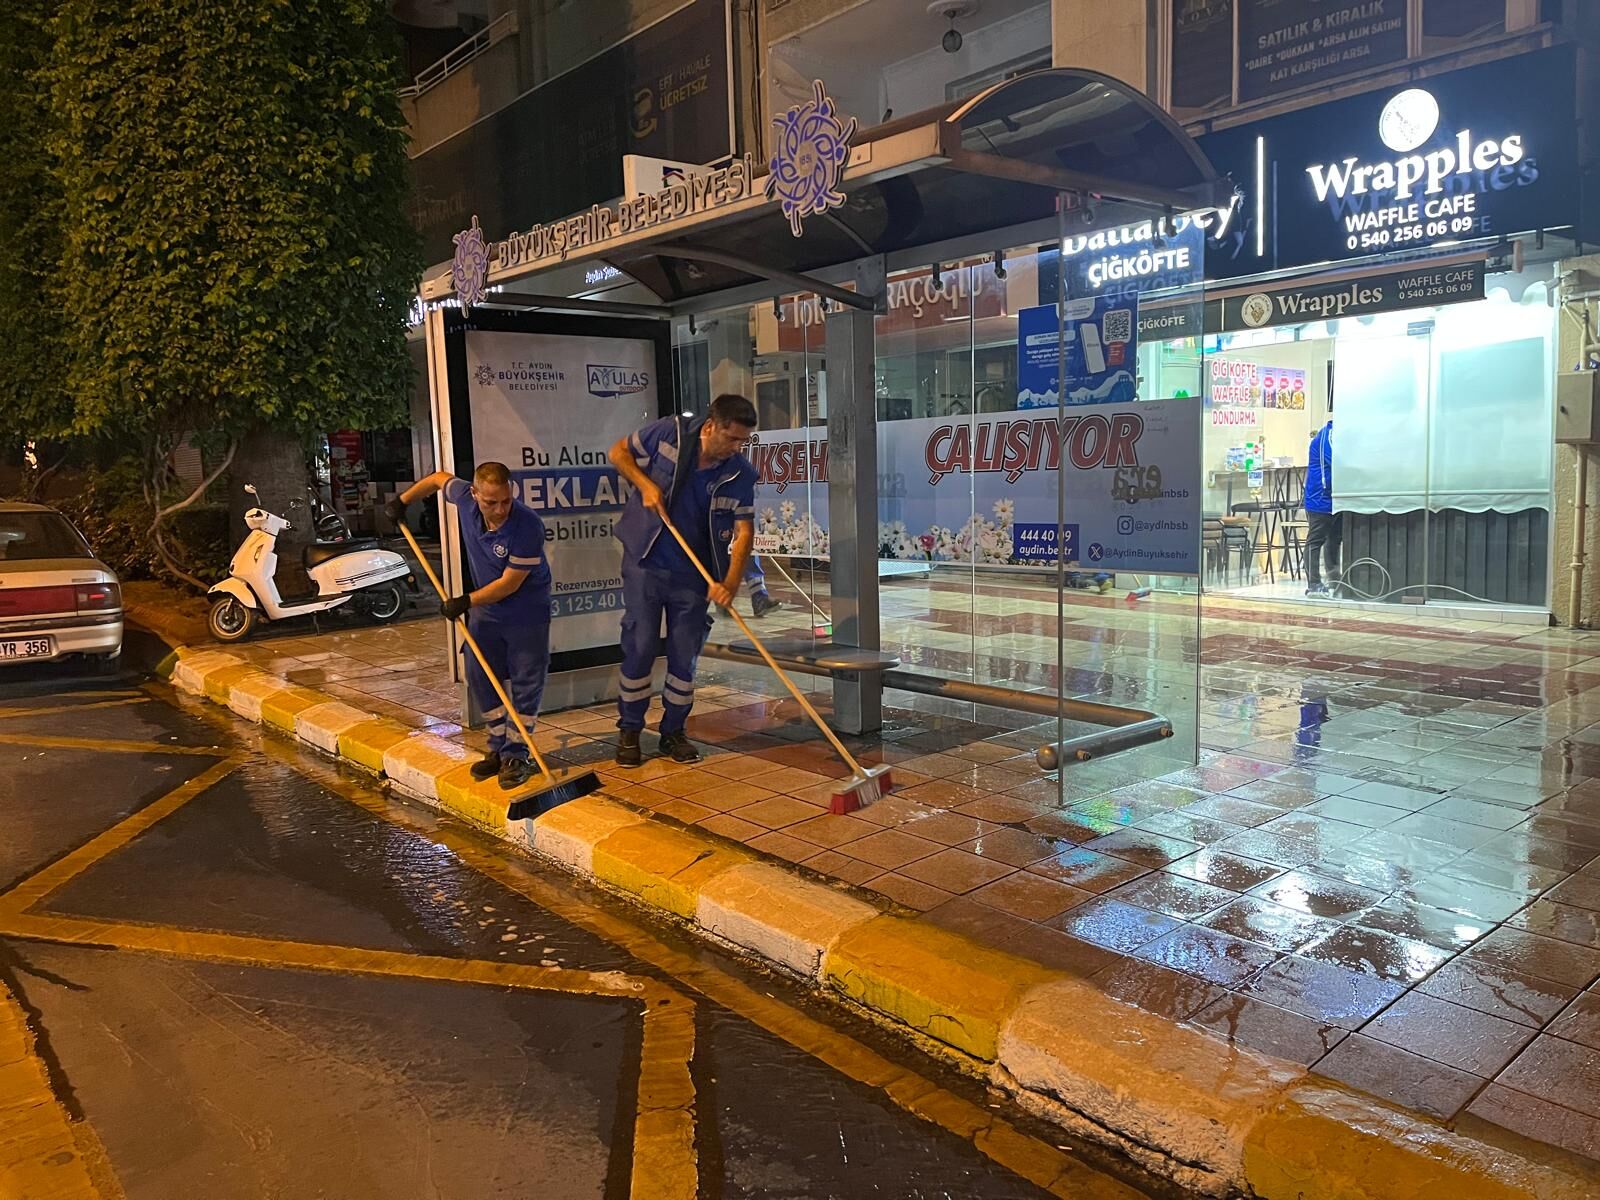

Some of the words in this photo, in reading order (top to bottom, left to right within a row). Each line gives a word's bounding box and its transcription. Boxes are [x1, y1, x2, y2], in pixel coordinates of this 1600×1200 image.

[1258, 21, 1308, 49] SATILIK
[1313, 18, 1323, 33] &
[1270, 67, 1289, 82] KAT
[1342, 44, 1371, 60] ARSA
[1306, 129, 1523, 202] Wrapples
[499, 203, 612, 268] BÜYÜKŞEHİR
[618, 152, 753, 232] BELEDİYESİ
[1346, 203, 1419, 233] WAFFLE
[1425, 194, 1476, 219] CAFE
[1347, 235, 1358, 250] 0
[1361, 230, 1390, 247] 540
[1394, 224, 1423, 242] 256
[1426, 219, 1448, 237] 06
[1451, 216, 1473, 233] 09
[1088, 247, 1190, 288] ÇİĞKÖFTE
[1398, 274, 1442, 290] WAFFLE
[1445, 269, 1475, 283] CAFE
[1276, 284, 1383, 317] Wrapples
[1399, 291, 1405, 300] 0
[1407, 289, 1424, 299] 540
[1427, 286, 1444, 296] 256
[1446, 284, 1458, 294] 06
[1460, 282, 1473, 292] 09
[1137, 315, 1185, 333] ÇİĞKÖFTE
[499, 371, 565, 382] BÜYÜKŞEHİR
[529, 362, 553, 370] AYDIN
[509, 383, 558, 391] BELEDİYESİ
[1213, 386, 1249, 402] WAFFLE
[1212, 410, 1256, 425] DONDURMA
[522, 447, 550, 467] Bu
[558, 445, 607, 466] Alan
[925, 413, 1144, 486] ÇALIŞIYOR
[512, 475, 636, 509] EKLA
[545, 519, 613, 542] ebilirsi
[1020, 529, 1039, 541] 444
[1041, 529, 1055, 542] 40
[1020, 545, 1073, 557] aydin.betr
[1105, 549, 1188, 561] @AydinBuyuksehir
[555, 577, 621, 592] Rezervasyon
[551, 599, 560, 616] 3
[566, 595, 593, 612] 125
[598, 592, 616, 608] 40
[0, 643, 17, 655] YR
[25, 641, 48, 654] 356
